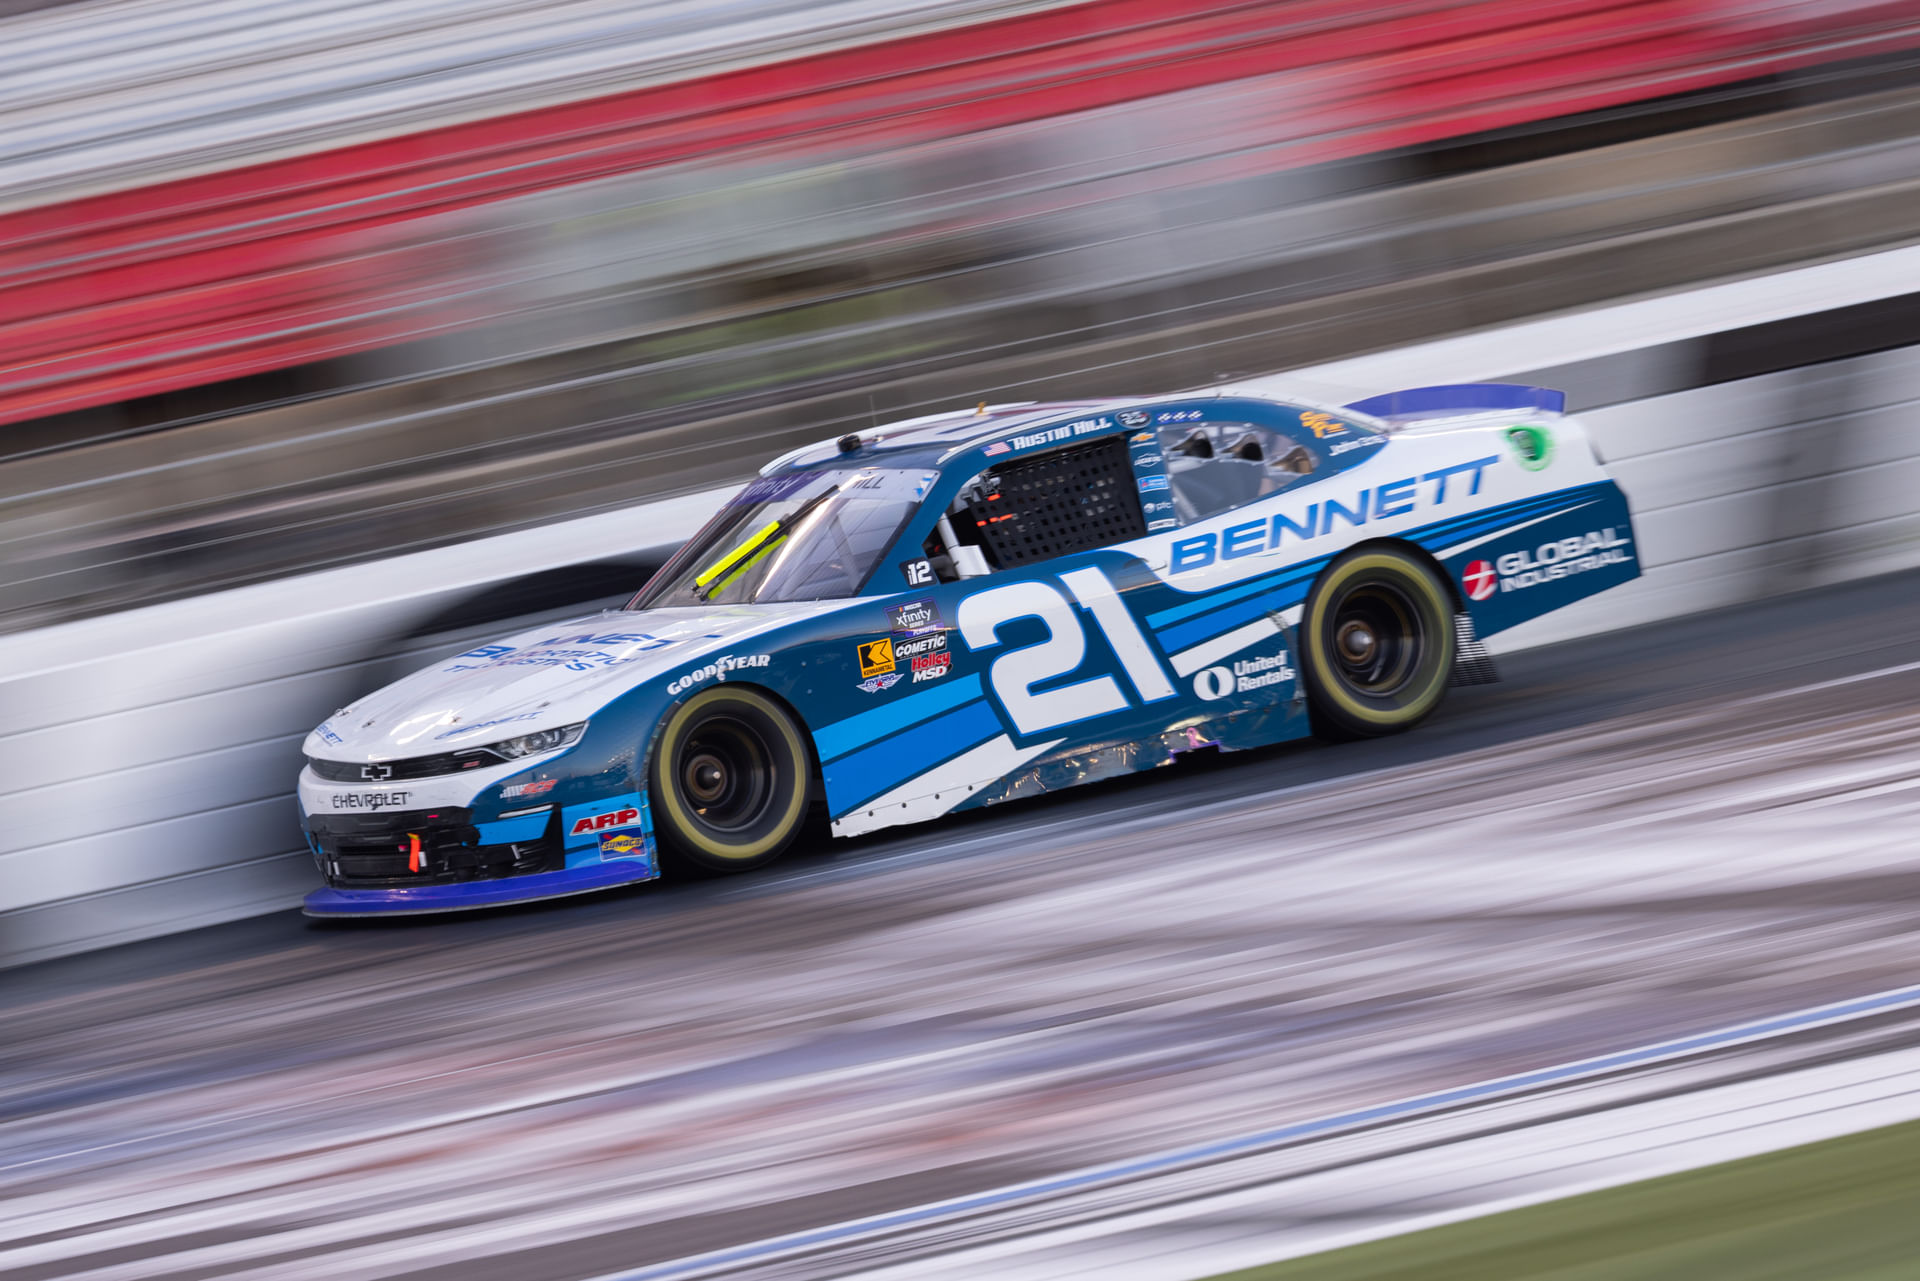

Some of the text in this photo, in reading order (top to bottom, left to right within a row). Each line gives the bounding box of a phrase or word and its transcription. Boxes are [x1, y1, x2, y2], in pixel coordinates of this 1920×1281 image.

[1069, 417, 1113, 435] HILL
[1169, 454, 1500, 576] BENNETT
[1496, 527, 1631, 576] GLOBAL
[1500, 549, 1634, 593] INDUSTRIAL
[896, 609, 931, 627] xfinity
[895, 635, 945, 658] COMETIC
[959, 566, 1178, 735] 21
[911, 651, 951, 671] Holley
[1234, 649, 1288, 677] United
[666, 655, 771, 695] GOODYEAR
[912, 665, 948, 683] MSD
[1237, 666, 1296, 693] Rentals
[332, 791, 408, 810] CHEVROLET
[572, 809, 639, 834] ARP
[602, 837, 643, 850] SUNOCO
